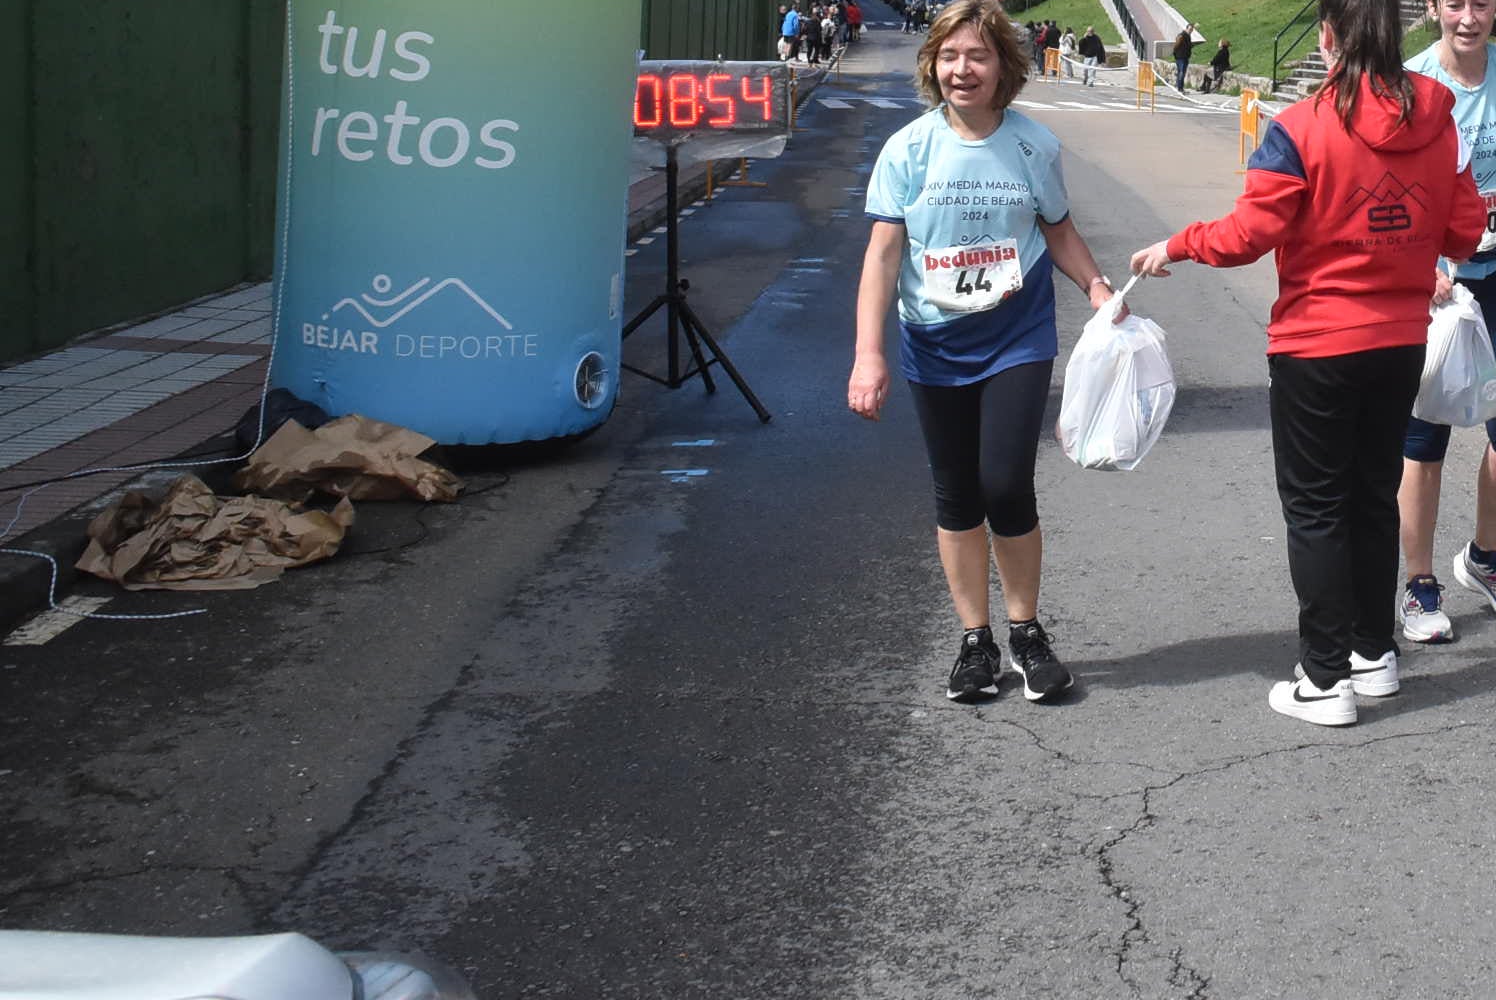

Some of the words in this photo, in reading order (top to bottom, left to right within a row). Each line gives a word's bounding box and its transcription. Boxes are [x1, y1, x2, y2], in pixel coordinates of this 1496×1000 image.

[318, 10, 435, 81] tus
[634, 73, 773, 127] 08:54
[311, 100, 520, 169] retos
[1476, 150, 1496, 160] 2024
[947, 180, 983, 190] MEDIA
[985, 180, 1029, 193] MARATÓ
[927, 196, 970, 206] CIUDAD
[972, 196, 989, 206] DE
[961, 211, 989, 221] 2024
[924, 245, 1016, 271] bedunia
[955, 267, 993, 296] 44
[395, 334, 538, 359] DEPORTE
